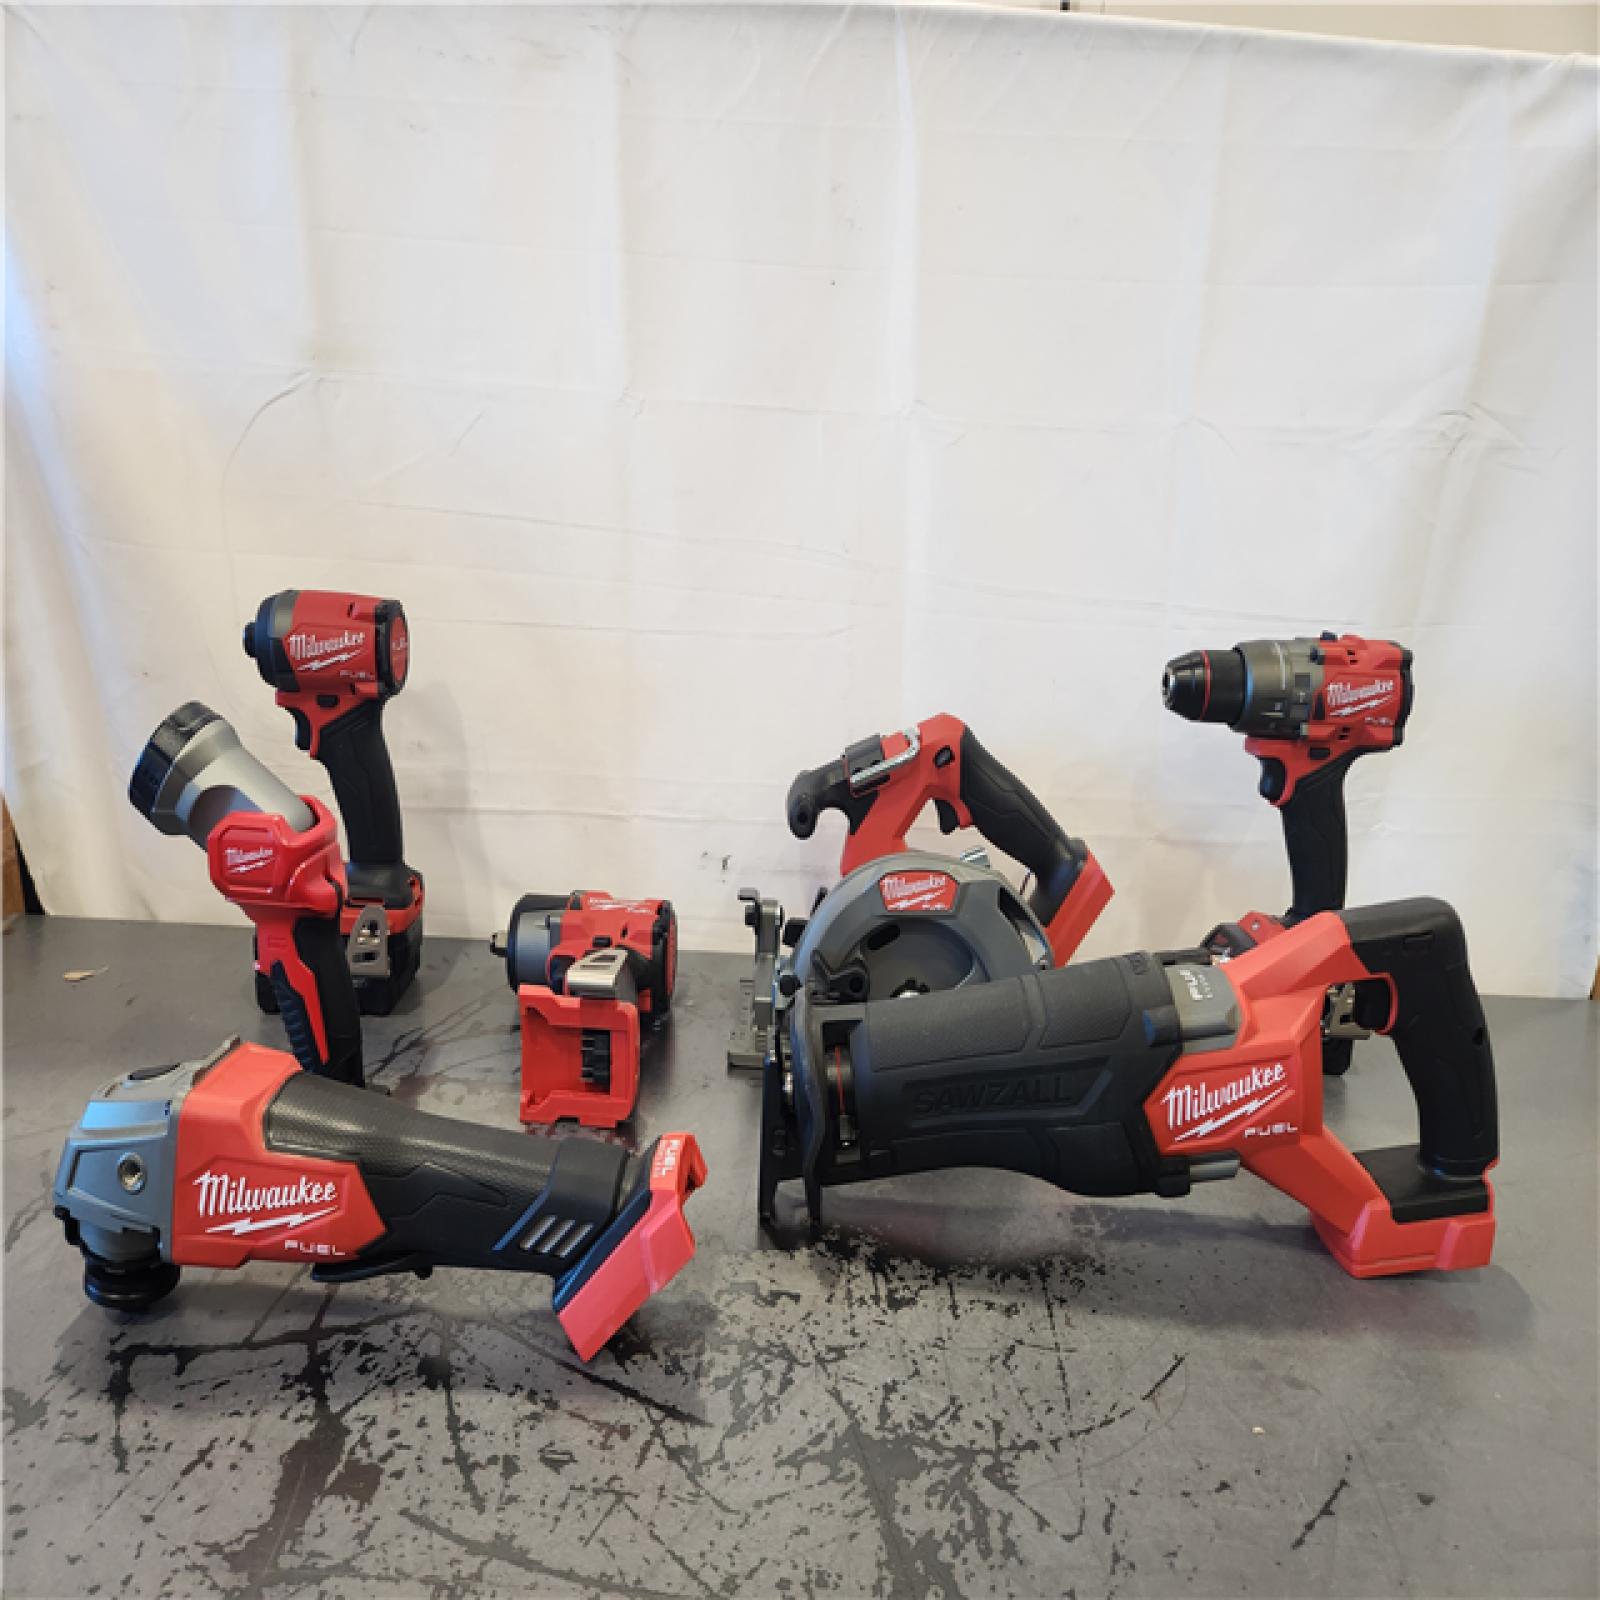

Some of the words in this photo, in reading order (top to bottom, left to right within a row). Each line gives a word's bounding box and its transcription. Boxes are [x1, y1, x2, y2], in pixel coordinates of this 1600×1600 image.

[1161, 1063, 1286, 1129] Milwaukee
[1244, 1122, 1298, 1138] FUEL
[192, 1169, 338, 1217] Milwaukee
[284, 1239, 346, 1256] FUEL
